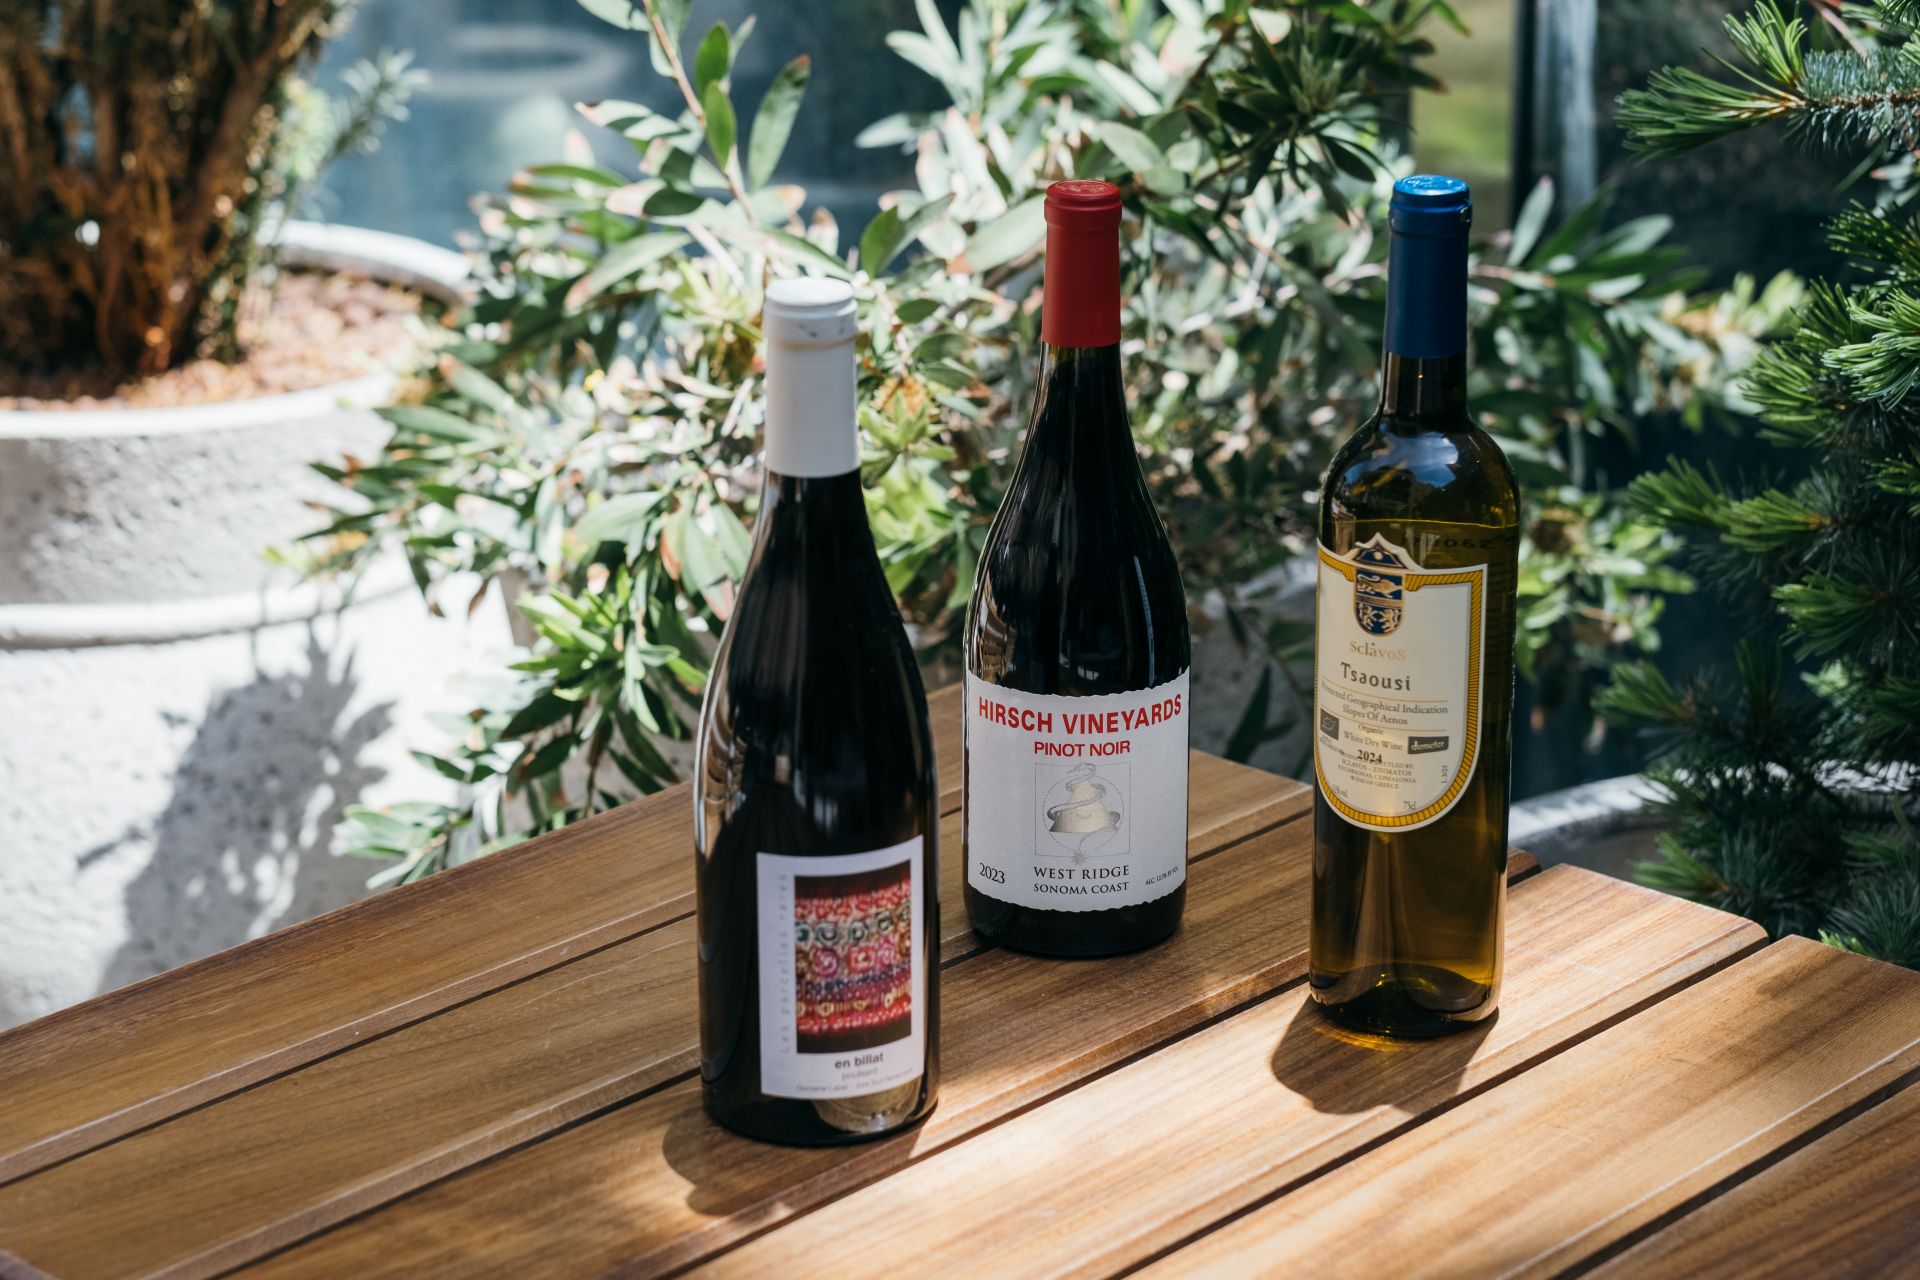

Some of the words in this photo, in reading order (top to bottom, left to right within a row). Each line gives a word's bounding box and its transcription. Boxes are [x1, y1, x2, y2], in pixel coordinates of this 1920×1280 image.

[1340, 661, 1411, 691] Tsaousi
[1347, 693, 1400, 713] Geographical
[1402, 704, 1448, 714] Indication
[979, 696, 1052, 733] HIRSCH
[1062, 693, 1182, 735] VINEYARDS
[1358, 723, 1384, 735] Organic
[1034, 741, 1085, 757] PINOT
[1090, 740, 1131, 757] NOIR
[1364, 736, 1380, 747] Dry
[1381, 741, 1403, 751] Wine
[1410, 739, 1446, 751] demeter
[1357, 749, 1383, 764] 2024
[979, 862, 1006, 884] 2023
[1034, 866, 1075, 880] WEST
[1082, 865, 1130, 880] RIDGE
[1034, 883, 1088, 895] SONOMA
[1091, 882, 1130, 894] COAST
[835, 1059, 850, 1069] en
[854, 1052, 884, 1067] billat
